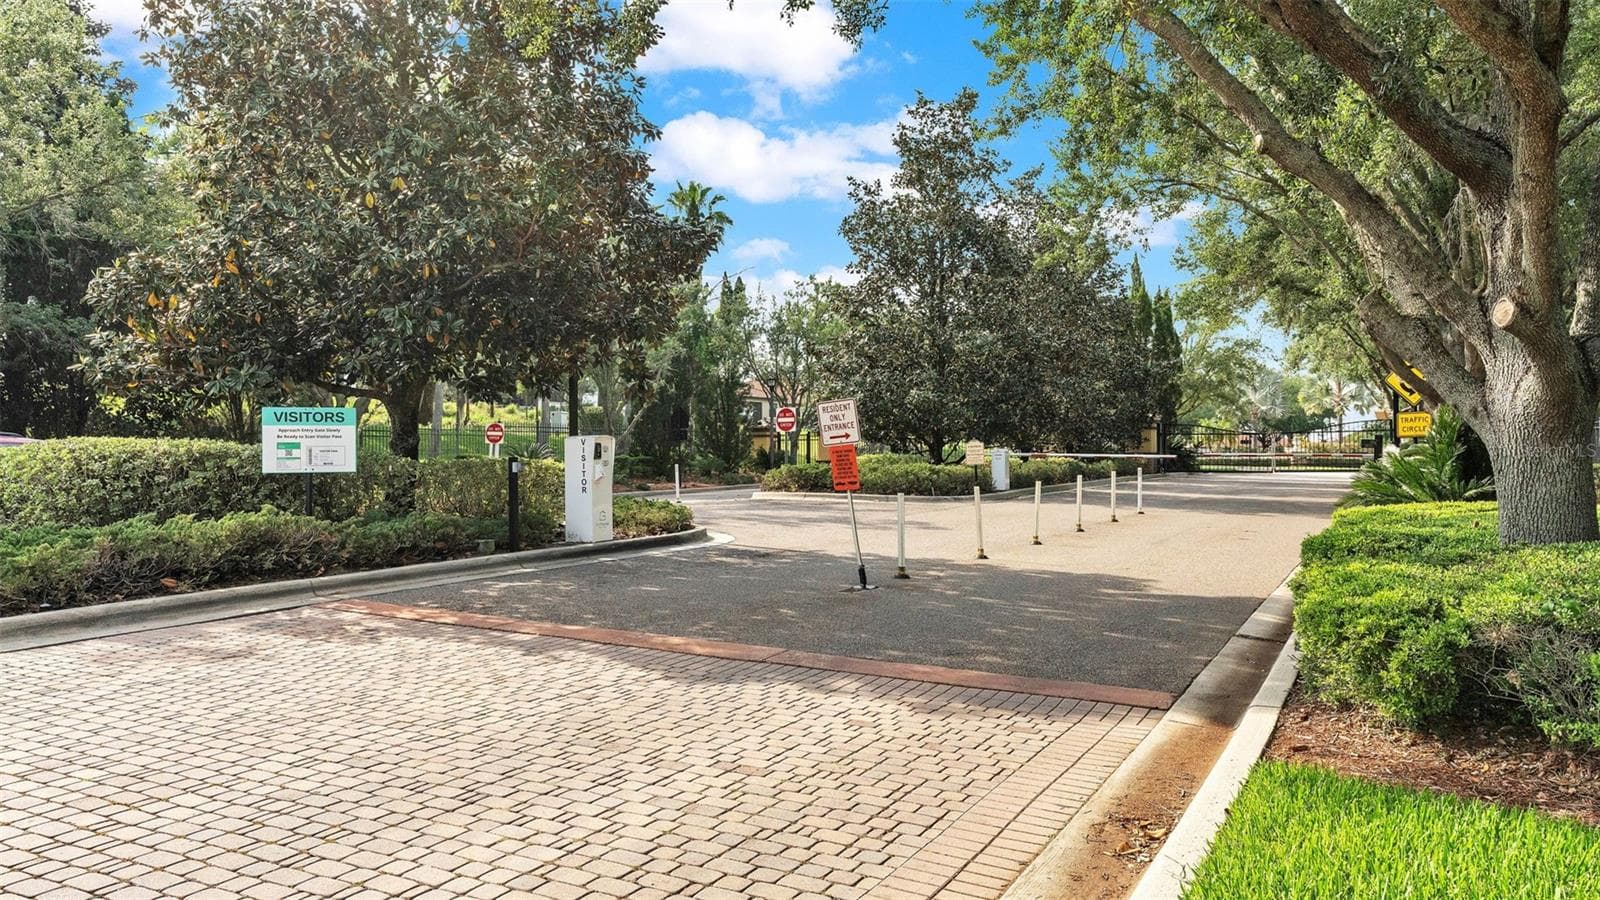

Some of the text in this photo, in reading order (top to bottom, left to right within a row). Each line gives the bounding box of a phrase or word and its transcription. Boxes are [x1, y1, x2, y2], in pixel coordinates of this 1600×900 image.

[822, 403, 851, 413] RESIDENT
[273, 411, 345, 423] VISITORS
[829, 413, 846, 422] ONLY
[1400, 416, 1429, 424] TRAFFIC
[823, 421, 855, 432] ENTRANCE
[1402, 425, 1427, 433] CIRCLE
[580, 438, 588, 494] VISITOR
